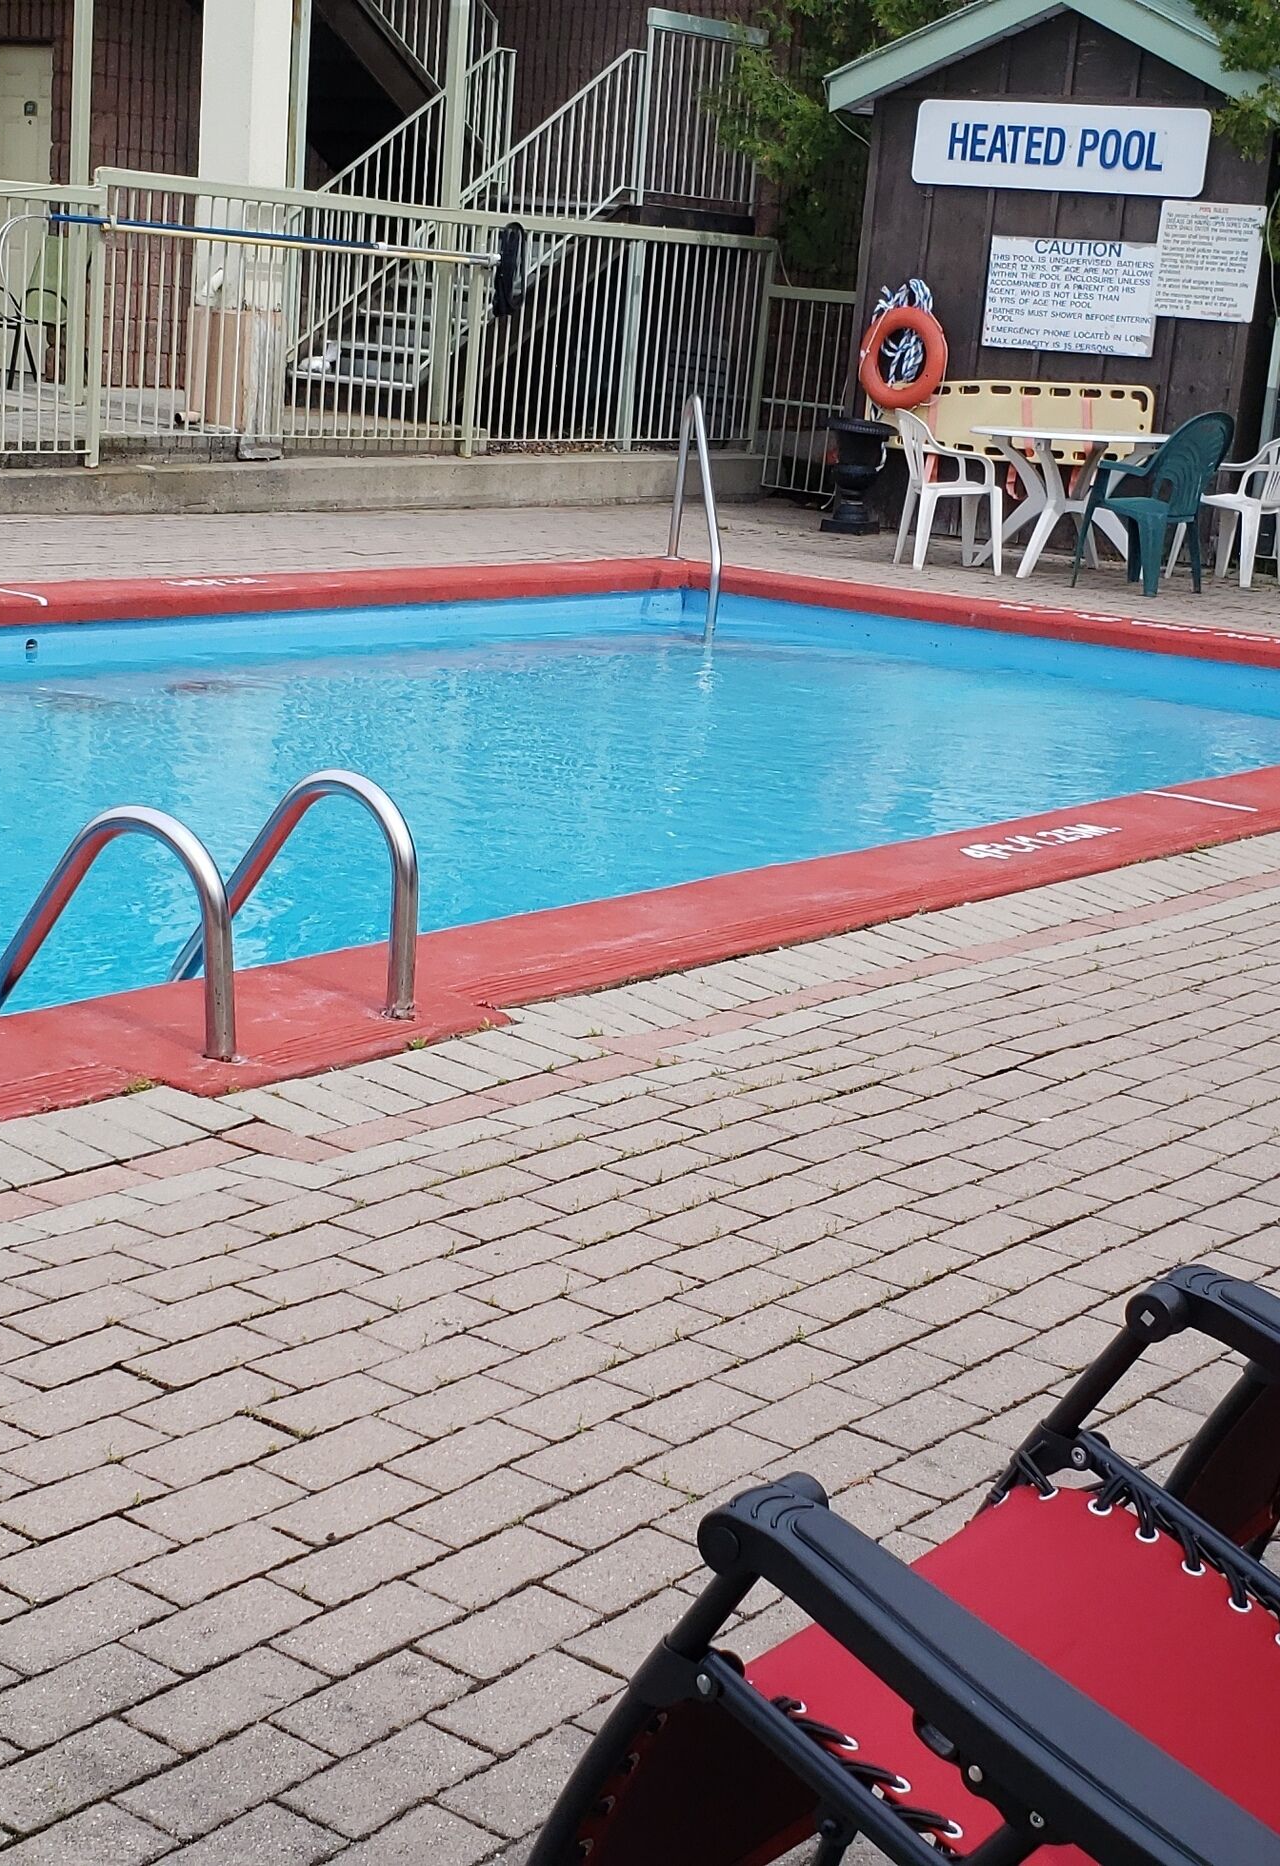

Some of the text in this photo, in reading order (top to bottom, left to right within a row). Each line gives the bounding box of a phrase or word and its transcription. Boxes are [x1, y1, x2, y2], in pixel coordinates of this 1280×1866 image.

[948, 123, 1162, 172] HEATED POOL
[1035, 239, 1122, 257] CAUTION
[991, 262, 1017, 270] UNDER
[1064, 266, 1080, 274] AGE
[1103, 268, 1119, 276] NOT
[1013, 255, 1035, 263] POOL
[1117, 260, 1154, 269] BATHERS
[991, 270, 1018, 278] WITHIN
[1040, 273, 1062, 281] POOL
[1065, 274, 1114, 284] ENCLOSURE
[1118, 277, 1151, 286] UNLESS
[990, 279, 1048, 288] ACCOMPANIED
[1073, 283, 1104, 292] PARENT
[1122, 286, 1136, 294] HIS
[1021, 289, 1040, 297] WHO
[1054, 291, 1070, 299] NOT
[1073, 293, 1095, 301] LESS
[1098, 294, 1120, 302] THAN
[1070, 301, 1092, 309] POOL
[992, 314, 1014, 322] POOL
[993, 307, 1025, 316] BATHERS
[1028, 309, 1049, 317] MUST
[1051, 311, 1083, 320] SHOWER
[1085, 313, 1116, 322] BEFORE
[991, 325, 1040, 336] EMERGENCY
[1043, 329, 1071, 338] PHONE
[1074, 331, 1110, 341] LOCATED
[1113, 334, 1122, 342] IN
[1011, 338, 1049, 349] CAPACITY
